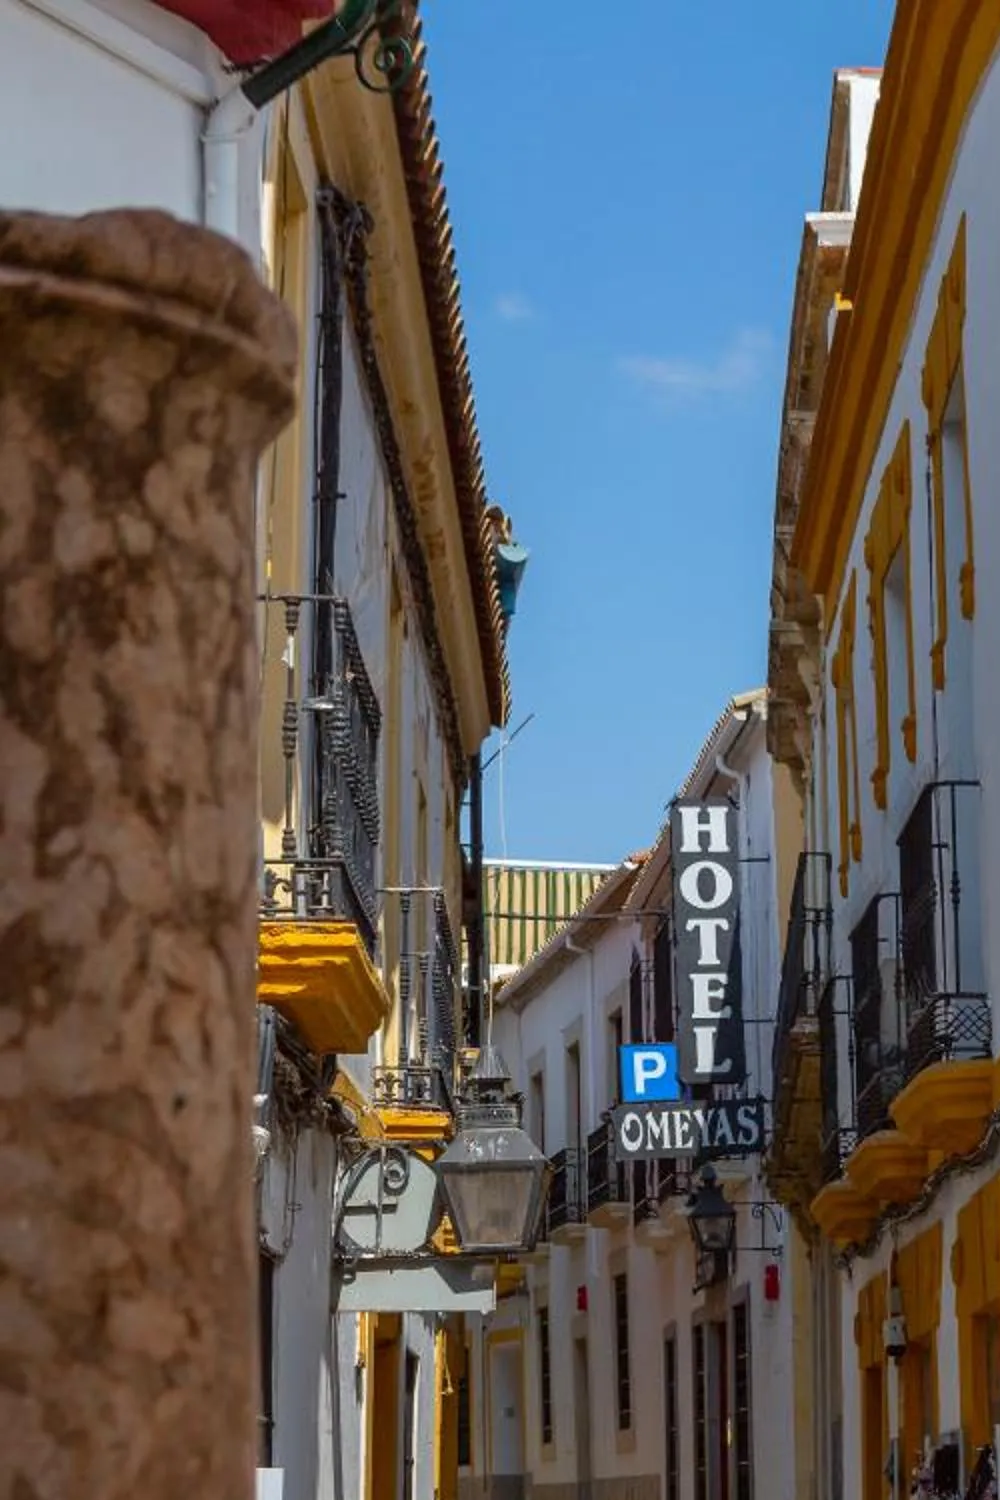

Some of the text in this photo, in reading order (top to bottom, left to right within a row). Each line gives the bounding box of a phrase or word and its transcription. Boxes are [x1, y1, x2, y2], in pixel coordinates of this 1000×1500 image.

[678, 806, 735, 1074] HOTEL
[633, 1051, 667, 1095] P
[621, 1105, 759, 1152] OMEYAS
